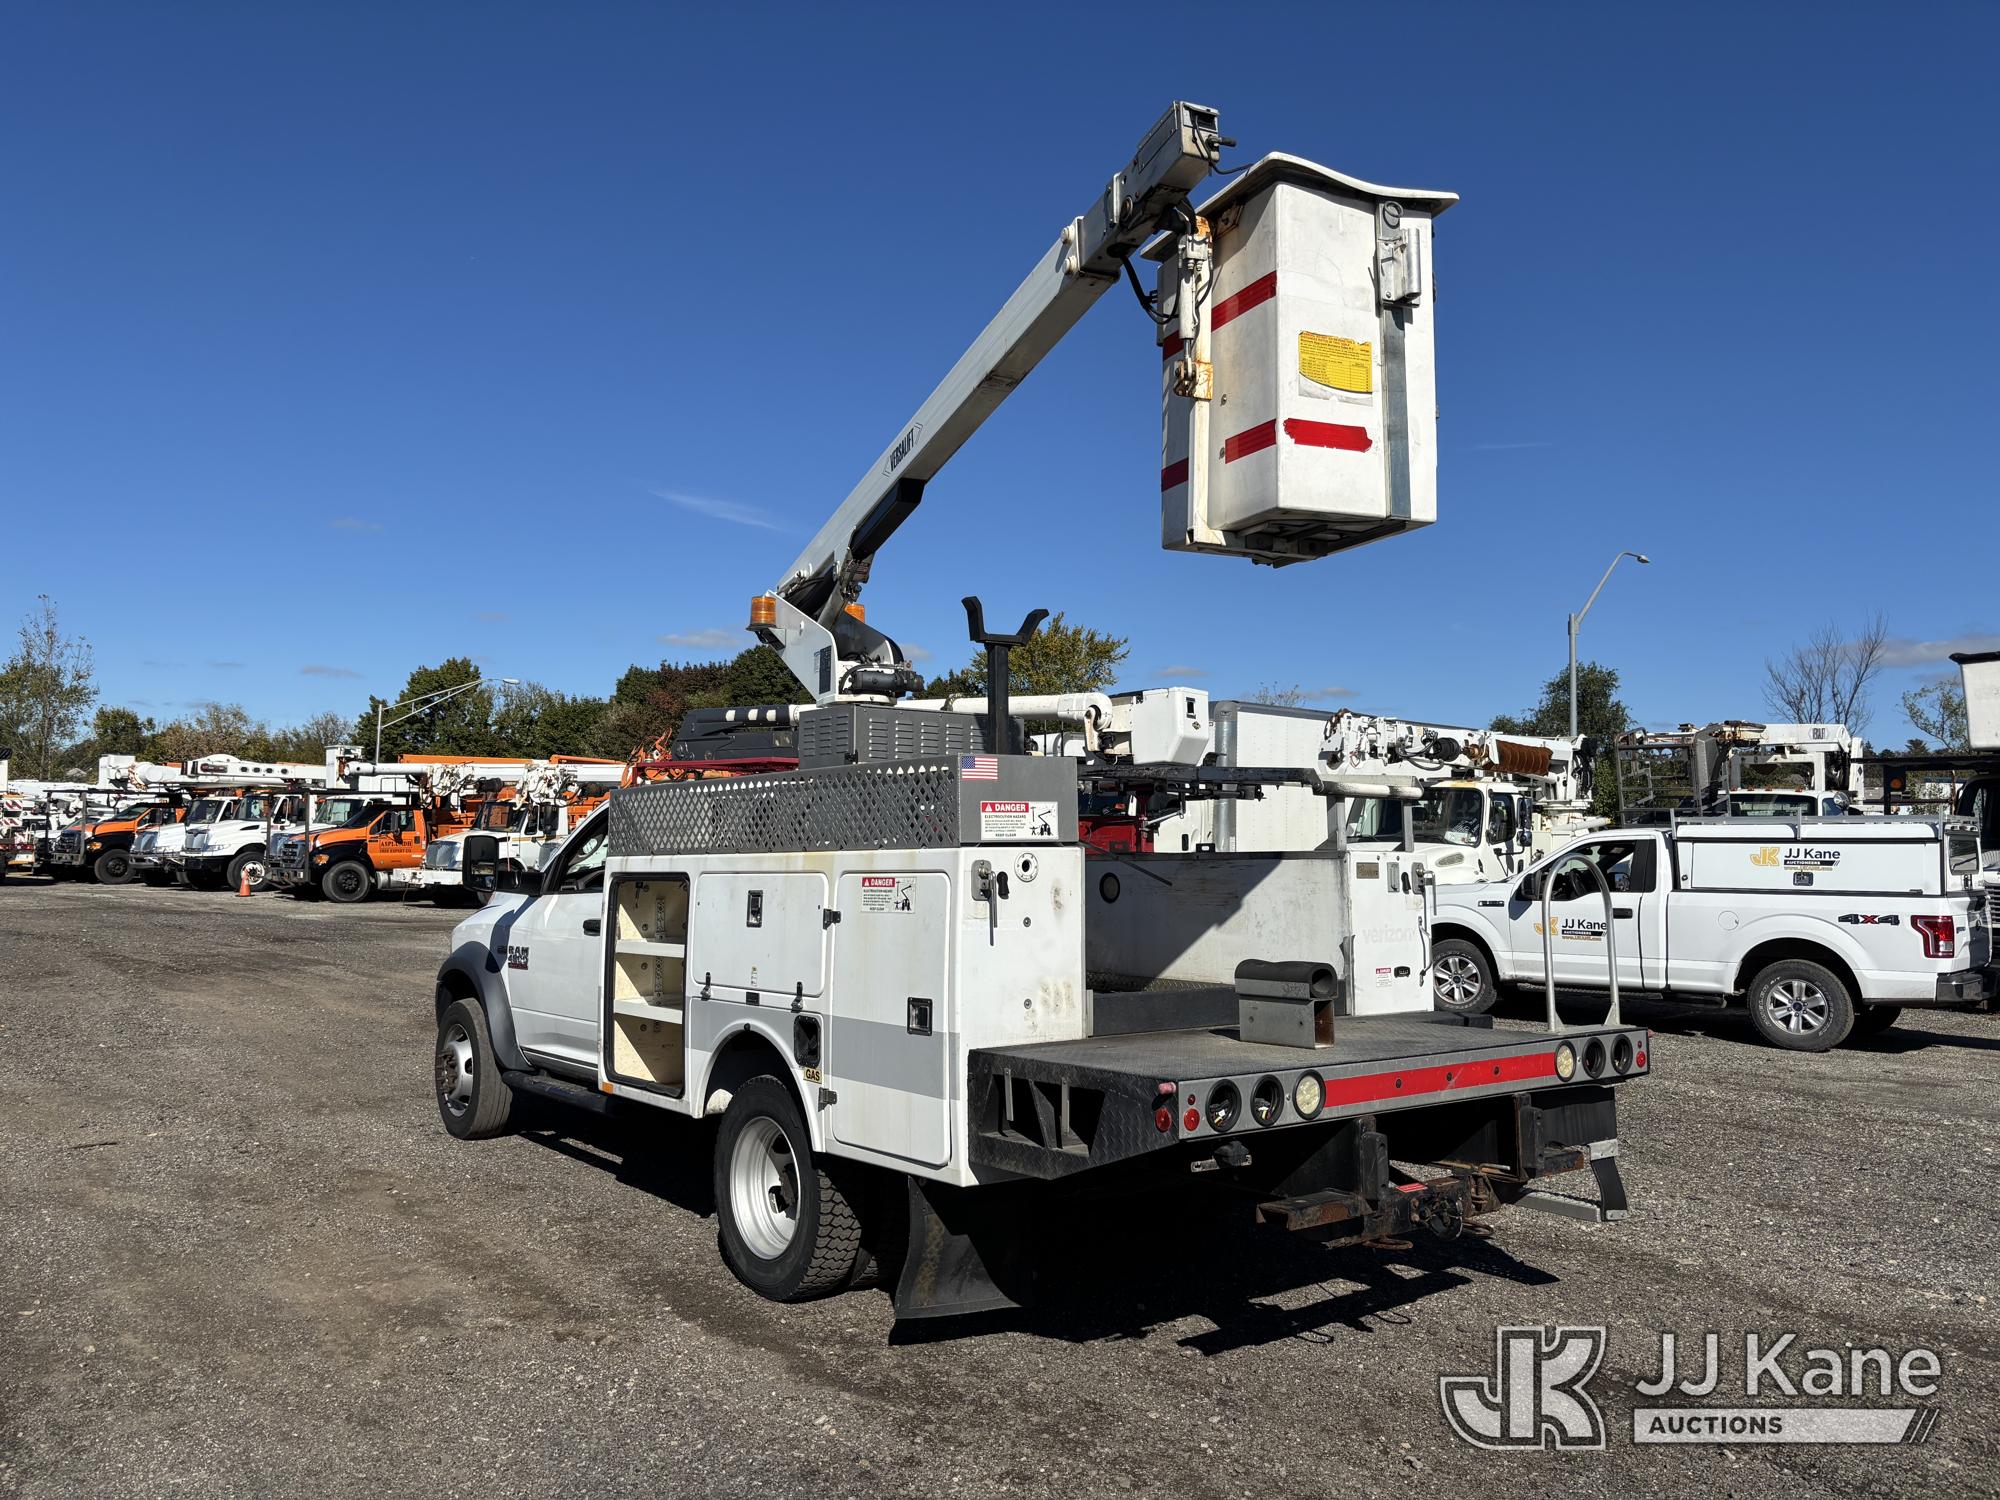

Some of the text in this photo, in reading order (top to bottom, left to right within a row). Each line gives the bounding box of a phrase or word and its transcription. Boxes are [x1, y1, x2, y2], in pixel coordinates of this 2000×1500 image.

[889, 427, 915, 472] VERSALIFT
[995, 803, 1026, 812] DANGER
[1784, 848, 1800, 859] JJ
[1804, 848, 1840, 859] Kane
[870, 878, 893, 886] DANGER
[1562, 919, 1575, 928] JJ
[1577, 919, 1607, 930] Kane
[508, 946, 529, 955] RAM
[805, 1069, 820, 1081] GAS
